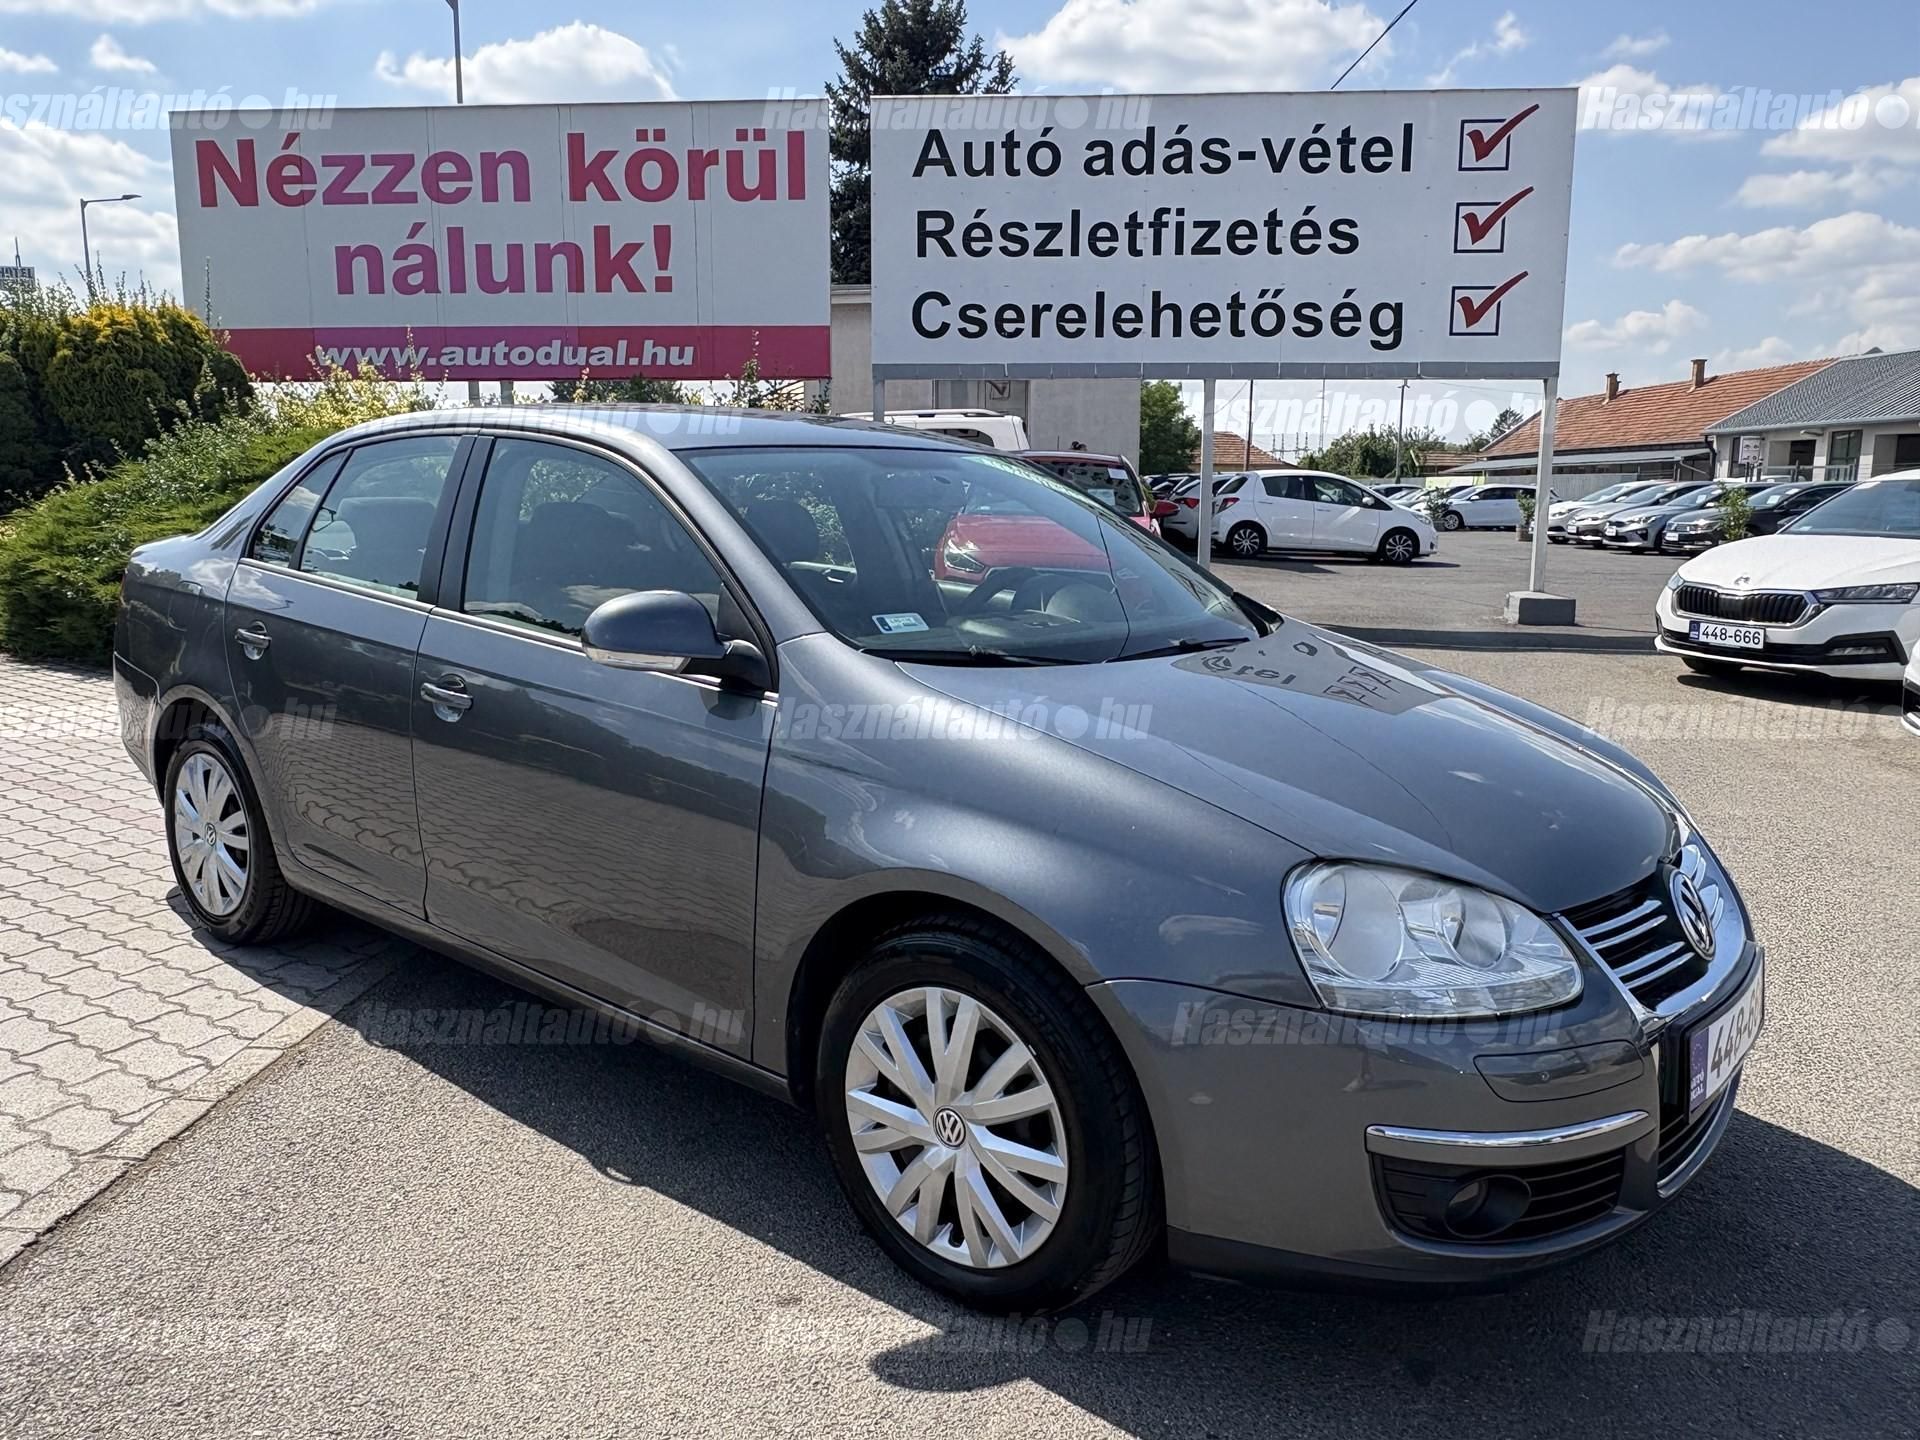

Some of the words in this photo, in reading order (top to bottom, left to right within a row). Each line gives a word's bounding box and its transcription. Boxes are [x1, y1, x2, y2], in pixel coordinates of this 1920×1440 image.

[195, 132, 532, 207] Nézzen
[567, 128, 806, 204] körül
[911, 126, 1062, 178] Autó
[1083, 123, 1414, 177] adás-vétel
[335, 221, 673, 295] nálunk!
[916, 206, 1361, 258] Részletfizetés
[911, 288, 1404, 351] Cserelehetőség
[315, 339, 694, 367] www.autodual.hu
[1702, 625, 1761, 645] 448-666
